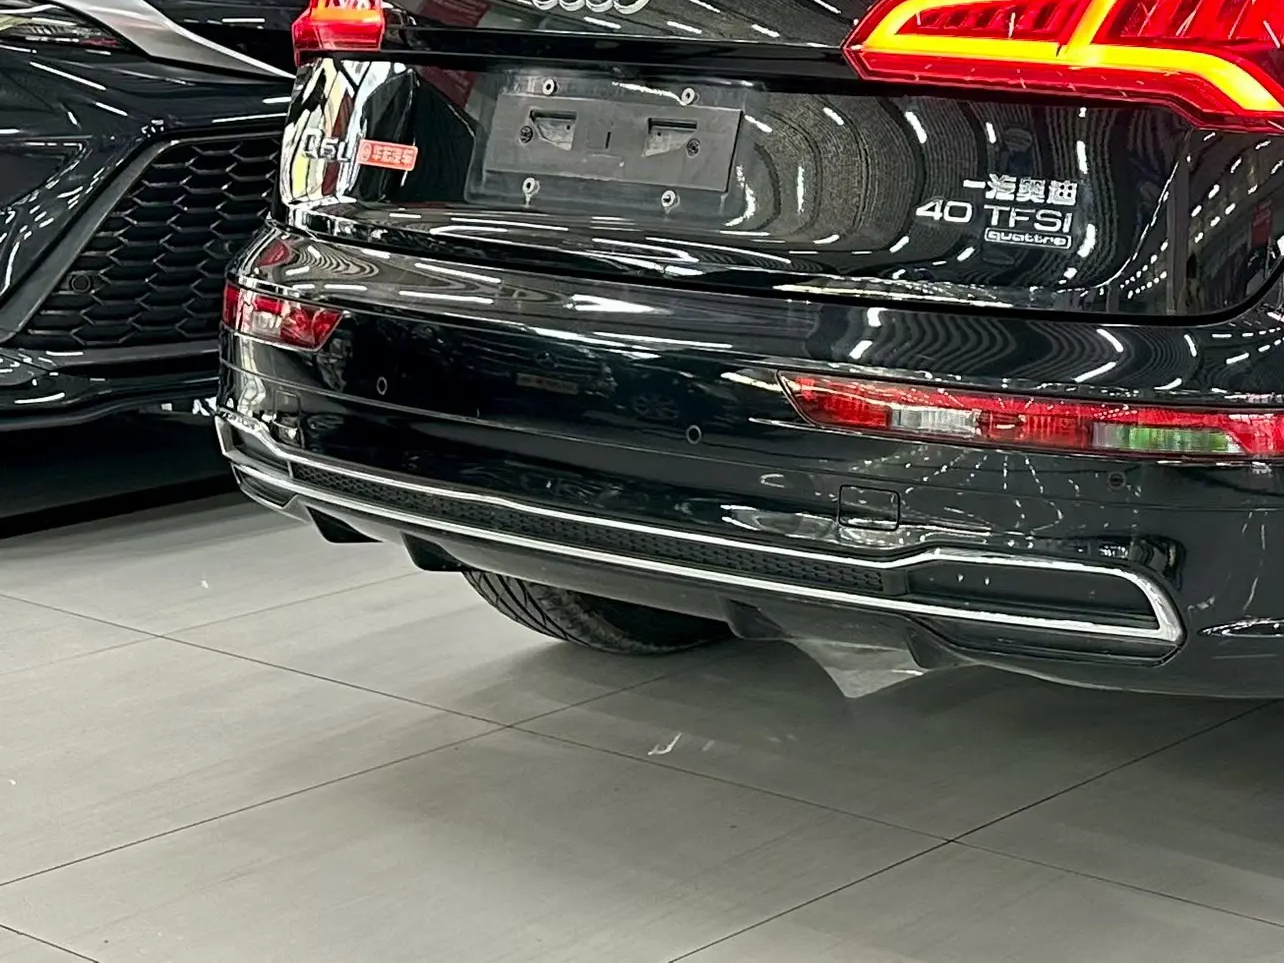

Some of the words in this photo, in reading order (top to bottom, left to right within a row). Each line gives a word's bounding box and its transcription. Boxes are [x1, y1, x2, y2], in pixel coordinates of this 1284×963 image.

[301, 128, 350, 162] Q5L
[963, 173, 1078, 206] 一汽奥迪
[915, 199, 973, 224] 40
[983, 204, 1074, 234] TFSI
[987, 232, 1069, 248] quattro
